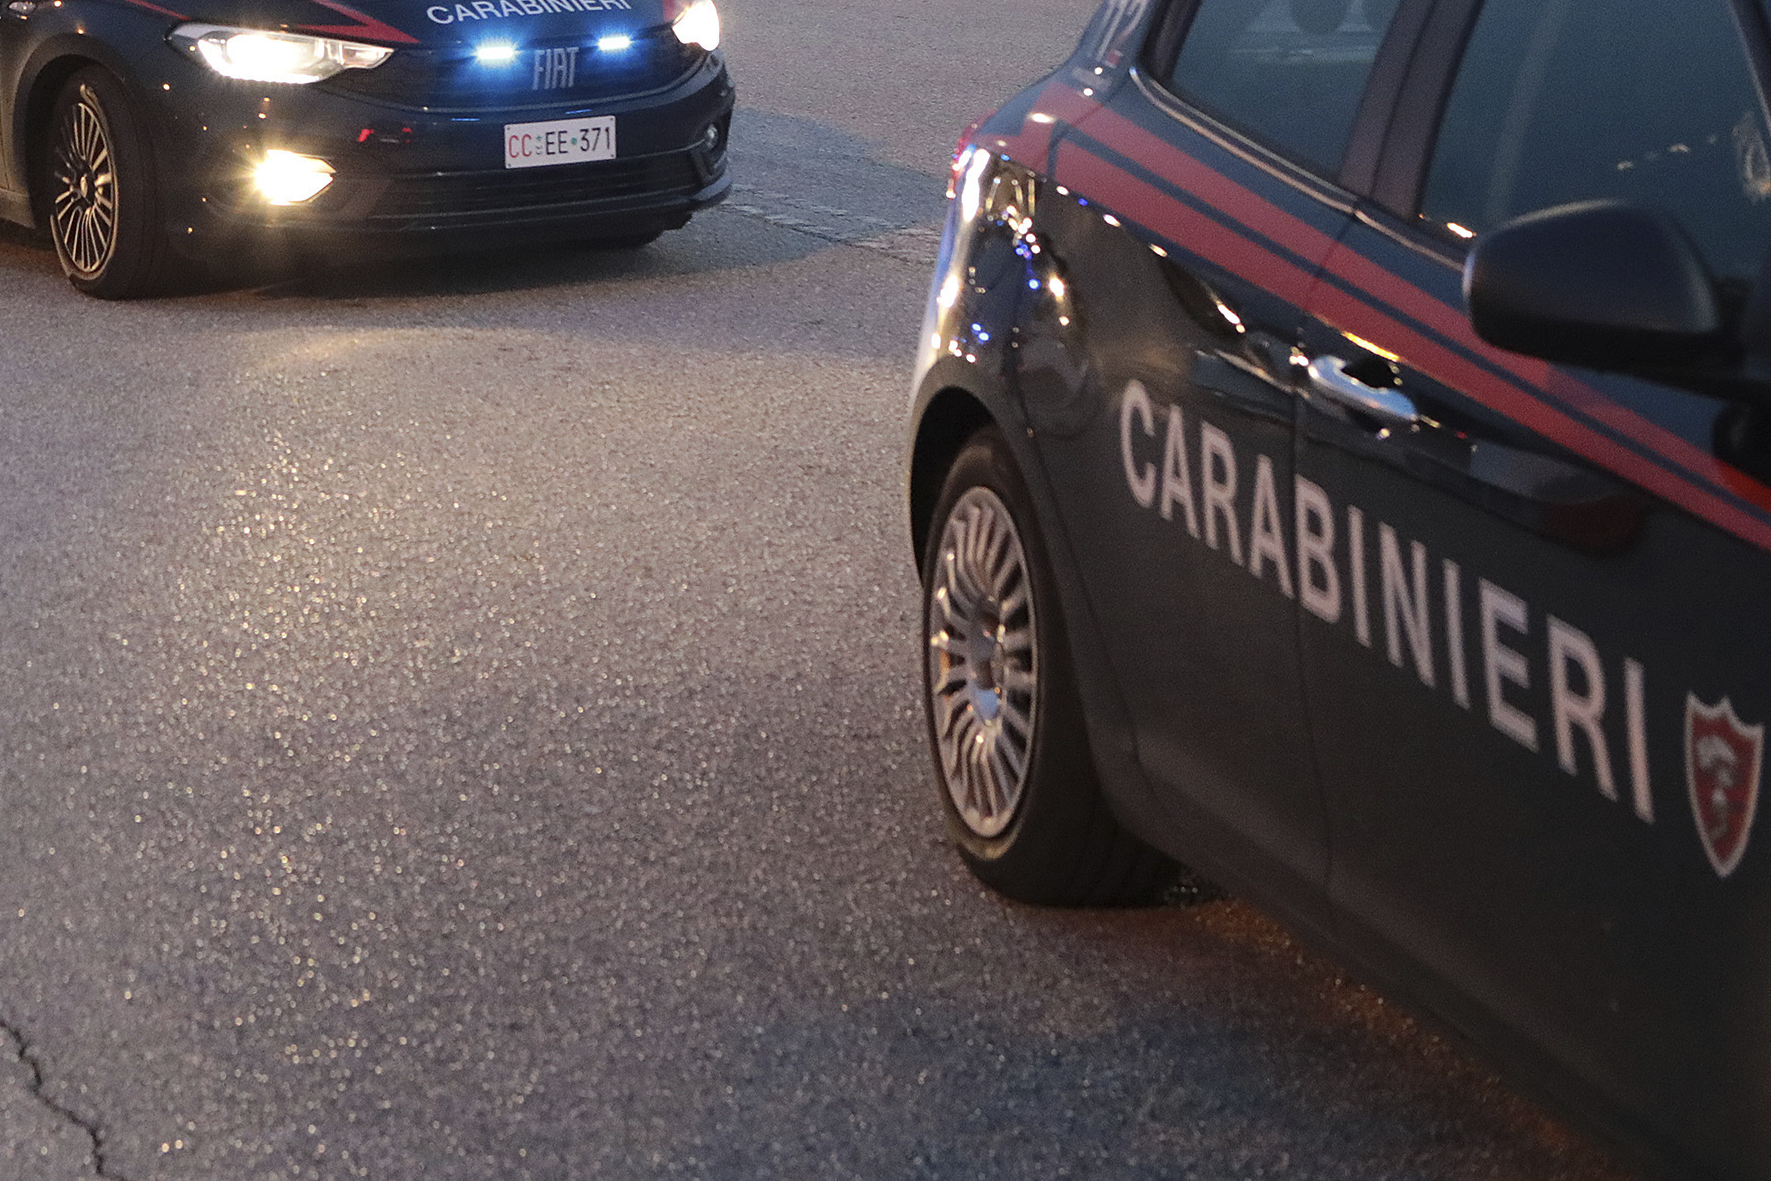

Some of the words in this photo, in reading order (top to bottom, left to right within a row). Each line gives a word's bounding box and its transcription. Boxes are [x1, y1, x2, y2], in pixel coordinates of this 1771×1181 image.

[532, 46, 580, 90] FIAT
[508, 134, 533, 158] CC
[545, 130, 568, 155] EE
[579, 126, 610, 152] 371
[1120, 378, 1655, 825] CARABINIERI
